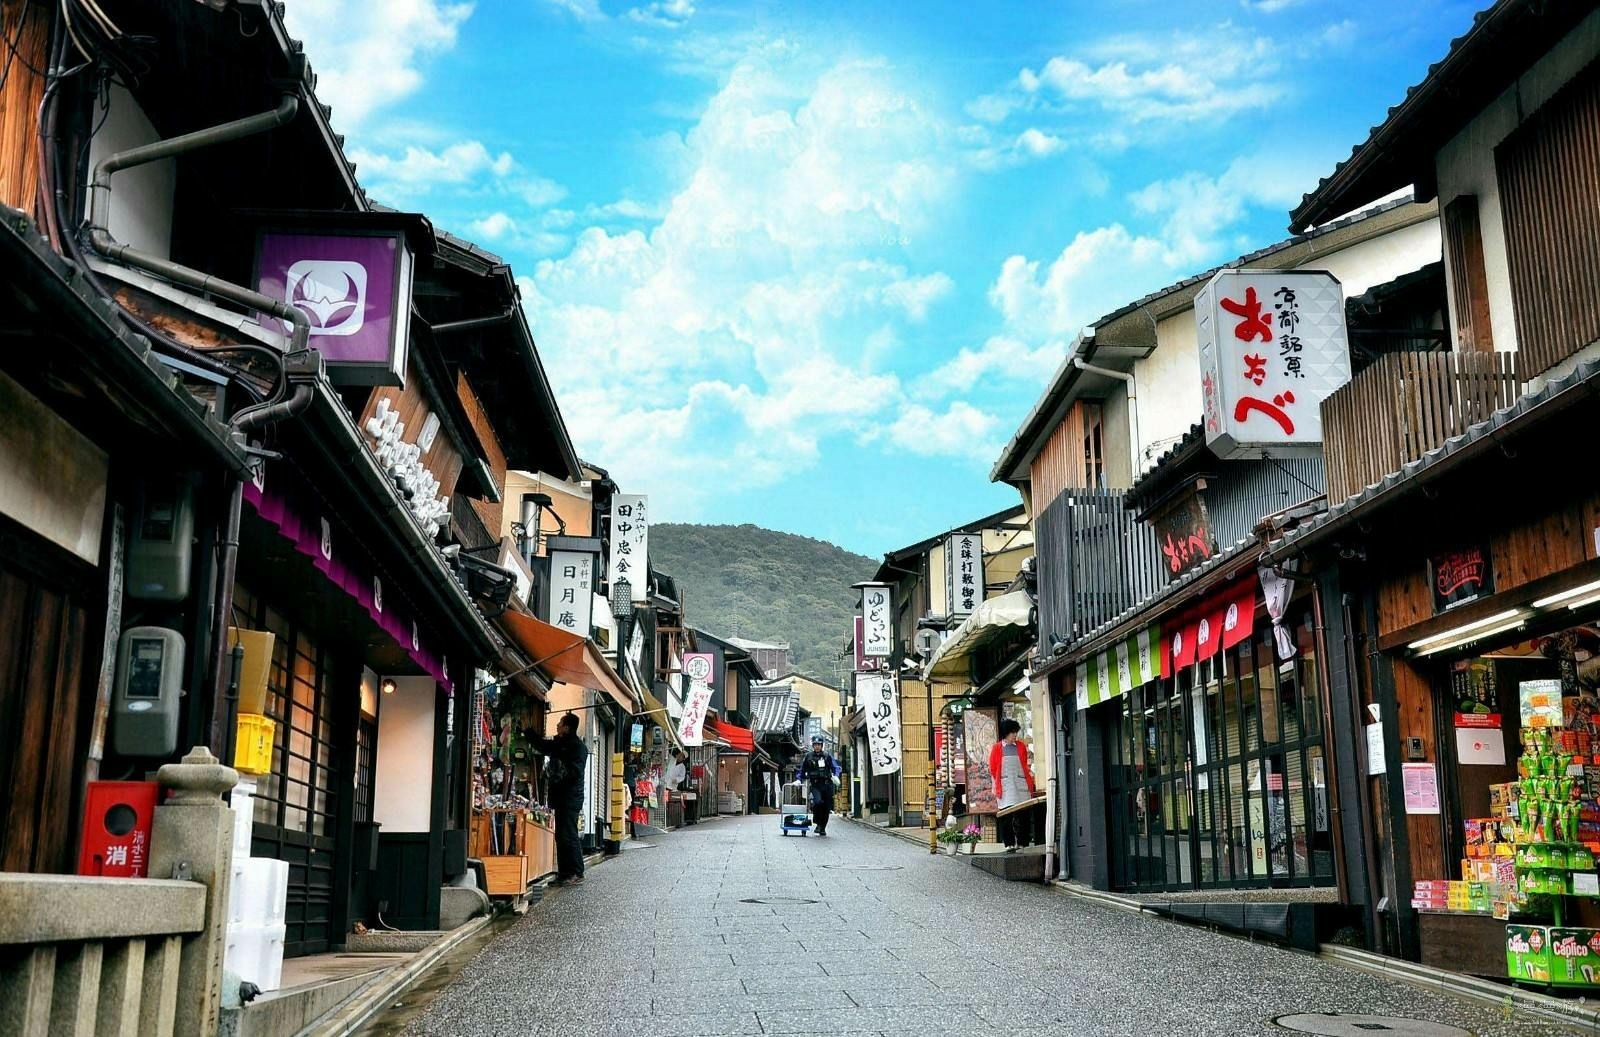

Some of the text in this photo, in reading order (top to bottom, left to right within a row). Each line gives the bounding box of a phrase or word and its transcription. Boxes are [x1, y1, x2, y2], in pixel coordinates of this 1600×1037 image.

[1220, 286, 1295, 435] おたべ
[1274, 287, 1305, 379] 京都銘菓
[557, 565, 577, 628] 日月庵
[580, 557, 590, 589] 京料理
[868, 592, 886, 644] ゆどうふ
[873, 702, 897, 767] ゆどうふ
[105, 845, 128, 865] 消
[1553, 940, 1588, 959] Caplico
